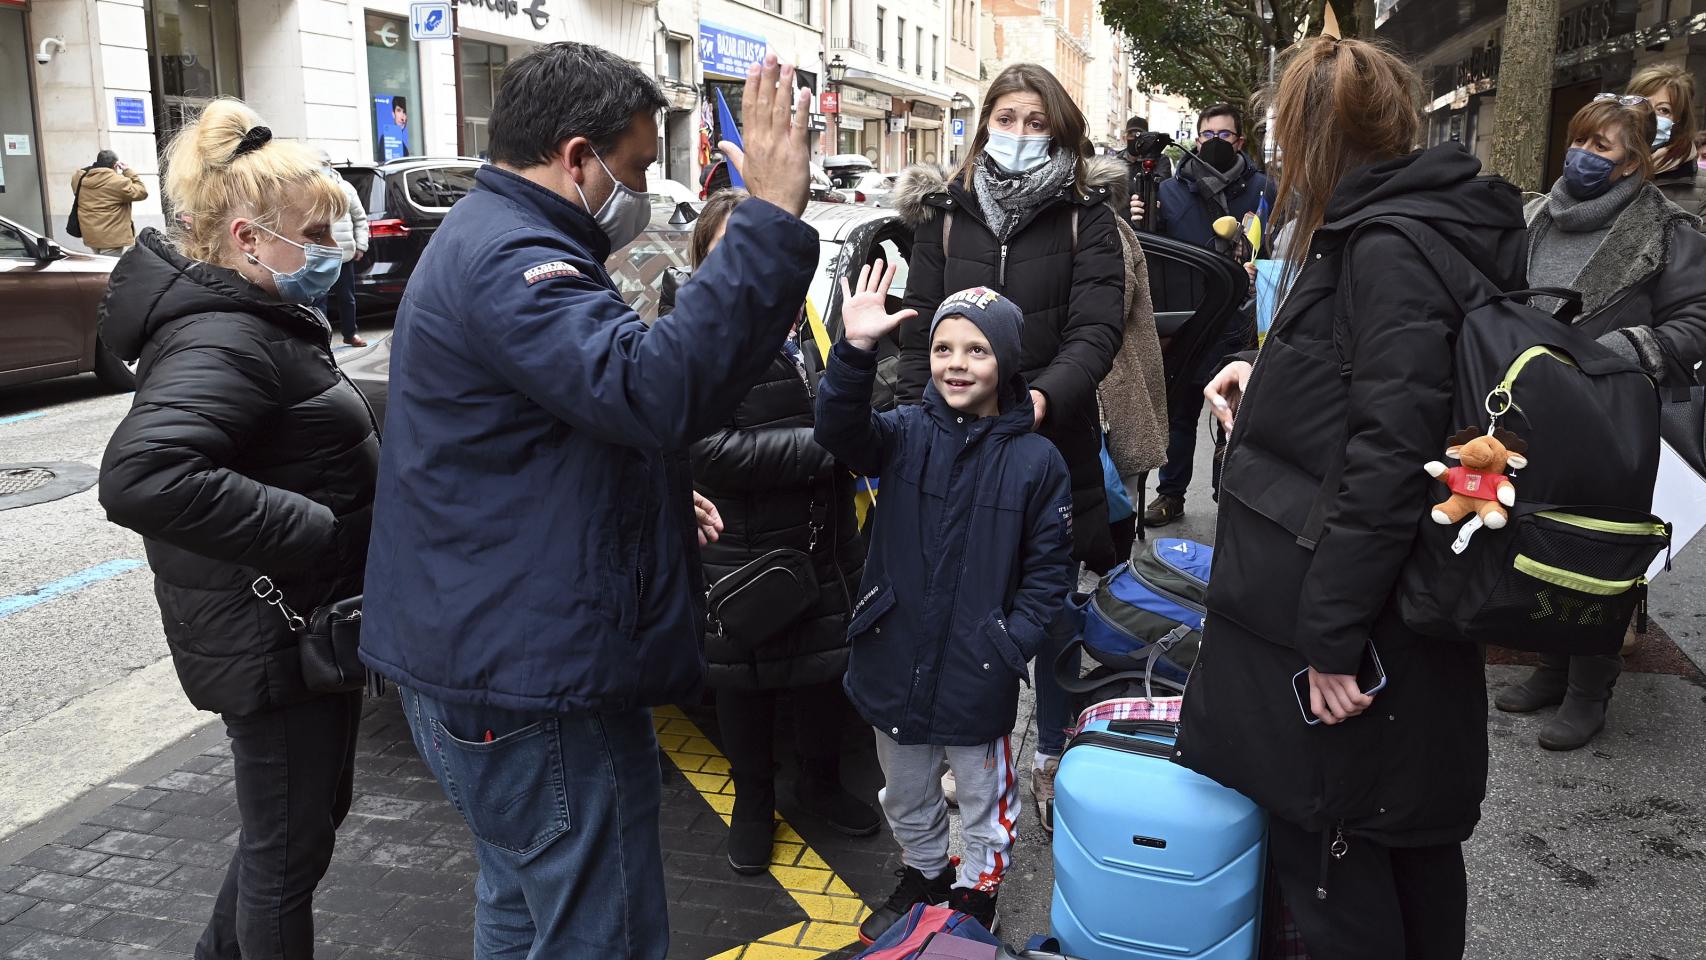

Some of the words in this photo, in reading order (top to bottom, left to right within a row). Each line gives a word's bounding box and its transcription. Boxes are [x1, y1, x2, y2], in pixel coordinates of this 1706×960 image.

[717, 33, 737, 59] BAZAR
[737, 39, 755, 62] ATLAS
[954, 121, 962, 133] P
